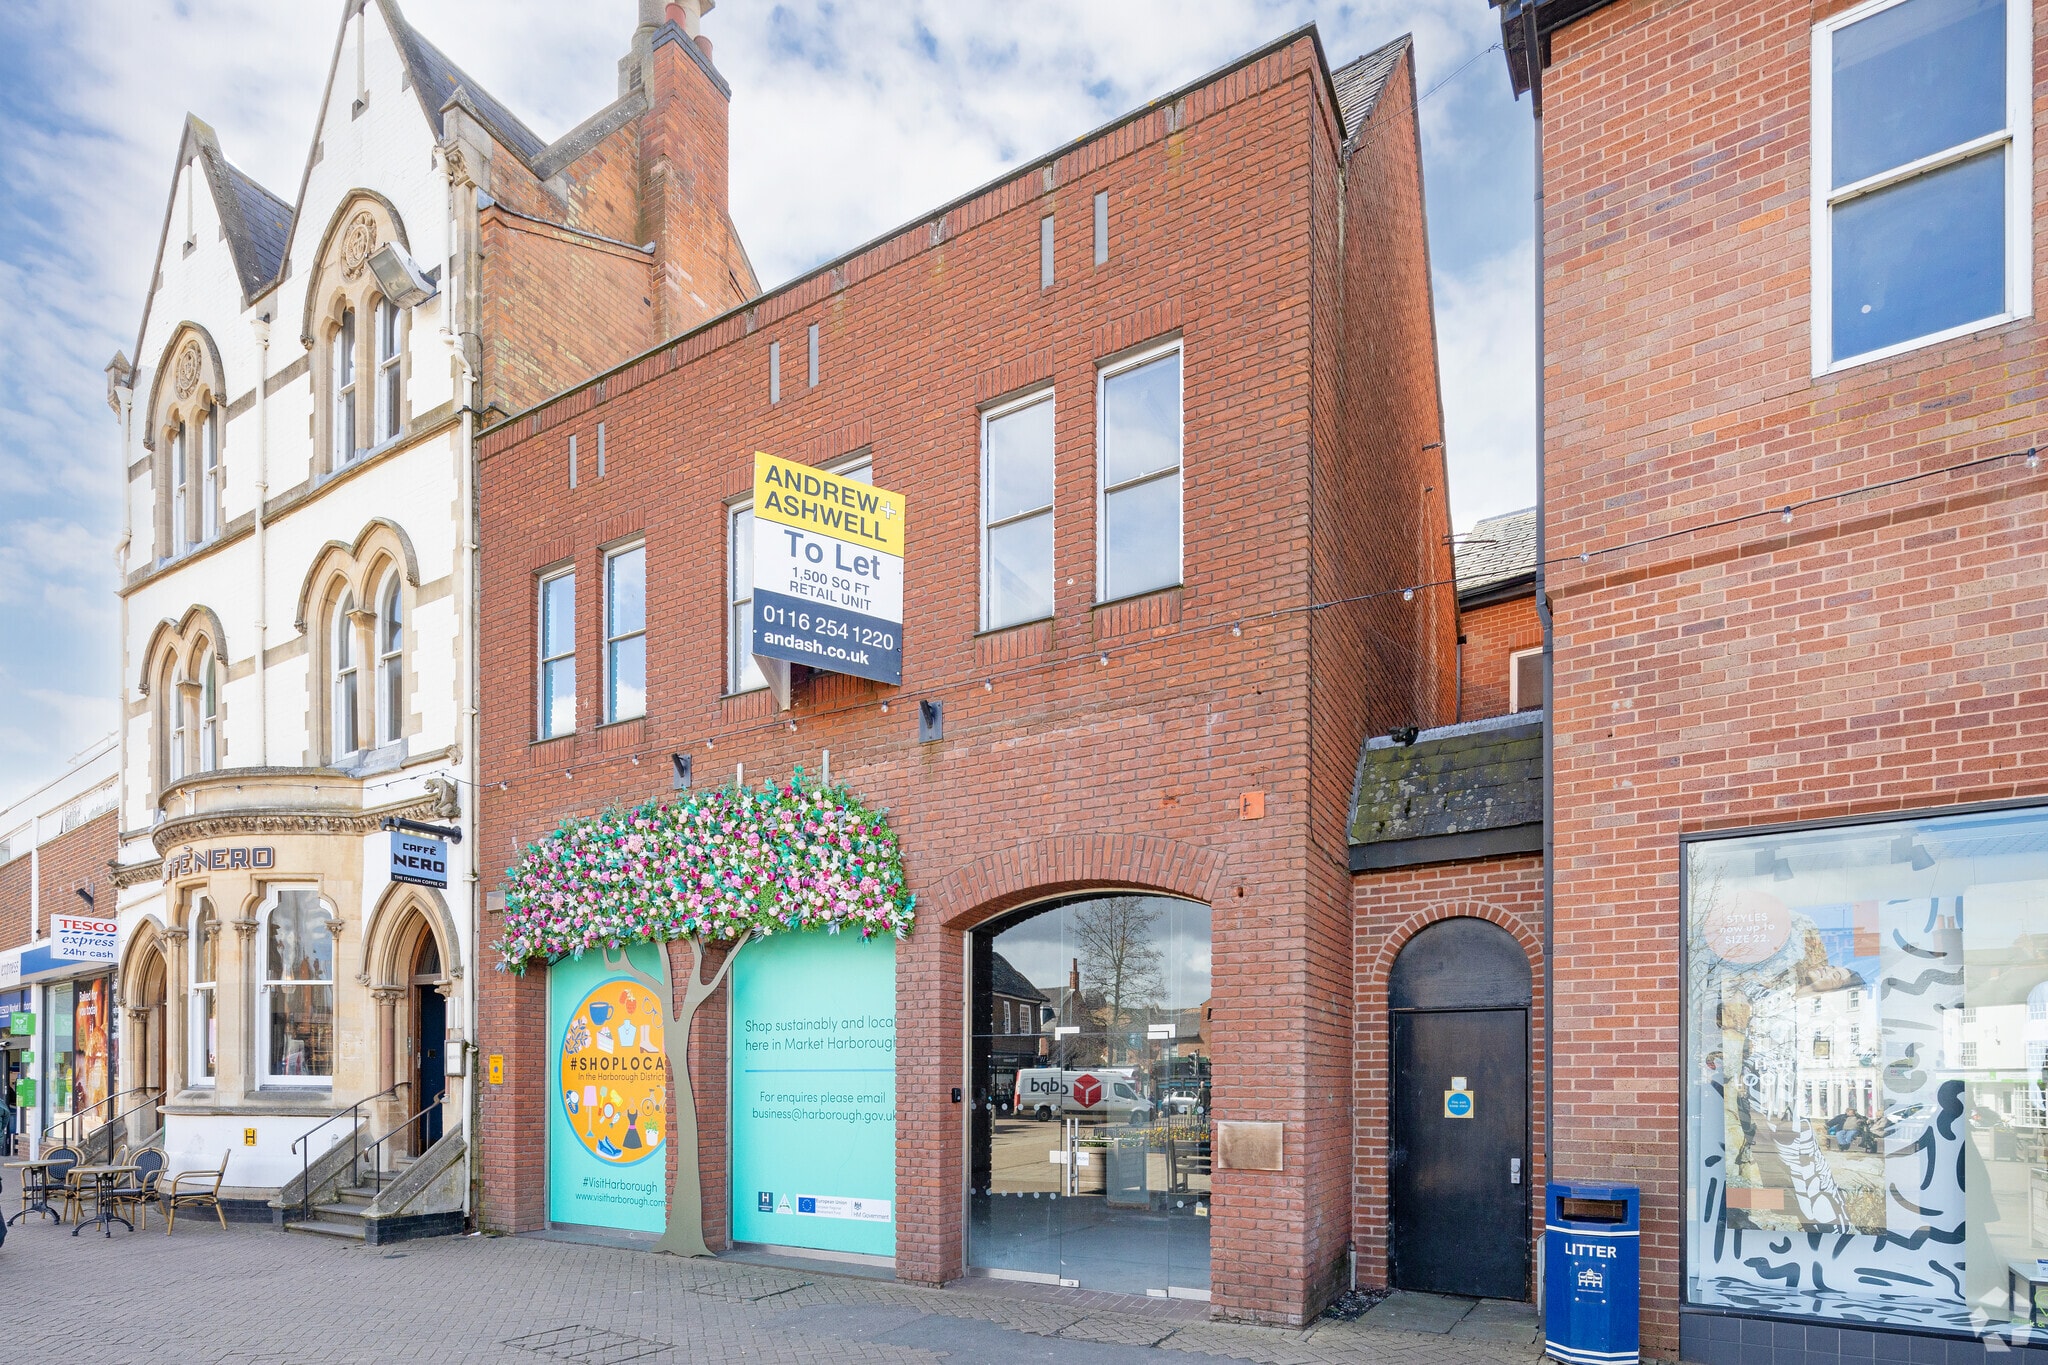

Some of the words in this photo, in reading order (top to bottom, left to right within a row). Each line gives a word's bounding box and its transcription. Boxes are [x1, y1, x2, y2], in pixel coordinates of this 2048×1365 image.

[764, 465, 879, 514] ANDREW
[764, 491, 888, 543] ASHWELL
[783, 529, 823, 564] To
[835, 543, 881, 581] Let
[792, 566, 828, 585] 1,500
[831, 576, 851, 591] SQ
[855, 583, 870, 596] FT
[789, 580, 837, 602] RETAIL
[841, 595, 871, 611] UNIT
[763, 605, 810, 631] 0116
[815, 617, 849, 640] 254
[853, 626, 894, 650] 1220
[764, 631, 869, 666] andash.co.uk
[194, 847, 275, 873] NERO
[393, 853, 445, 873] NERO
[404, 875, 421, 883] ITALIAN
[1726, 912, 1768, 923] STYLES
[59, 919, 117, 933] TESCO
[1720, 926, 1743, 934] now
[1746, 925, 1760, 935] up
[1764, 922, 1775, 931] to
[61, 936, 115, 947] express
[1725, 934, 1750, 944] SIZE
[63, 947, 87, 956] 24hr
[89, 950, 114, 958] cash
[745, 1020, 772, 1034] Shop
[775, 1017, 838, 1032] sustainably
[841, 1016, 864, 1029] and
[745, 1039, 769, 1050] here
[772, 1039, 782, 1050] in
[785, 1037, 824, 1050] Market
[570, 1057, 664, 1071] #SHOPLOCA
[598, 1073, 639, 1083] Harborough
[760, 1091, 775, 1102] For
[777, 1092, 818, 1105] enquires
[820, 1092, 854, 1105] please
[857, 1092, 886, 1104] email
[245, 1129, 255, 1144] H
[583, 1177, 658, 1195] #VisitHarborough
[575, 1193, 665, 1208] www.visitharborough.com
[761, 1192, 770, 1203] H
[862, 1212, 890, 1220] Government
[1565, 1242, 1617, 1258] LITTER
